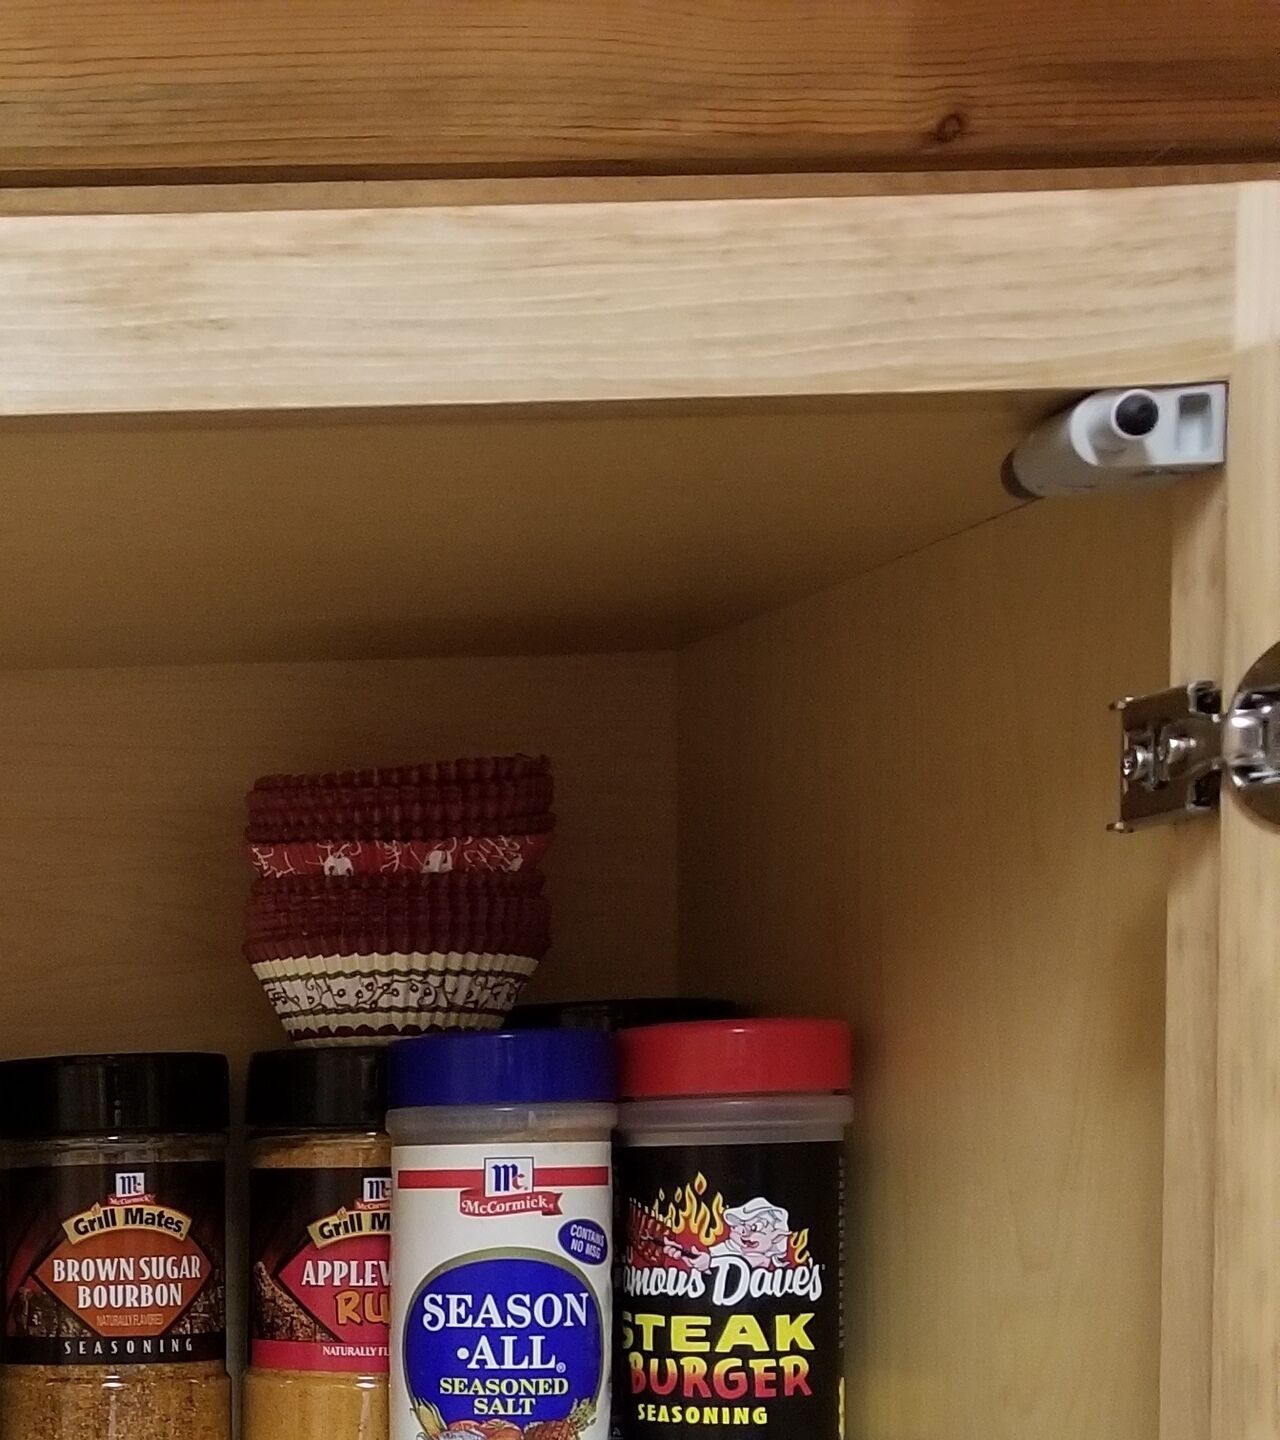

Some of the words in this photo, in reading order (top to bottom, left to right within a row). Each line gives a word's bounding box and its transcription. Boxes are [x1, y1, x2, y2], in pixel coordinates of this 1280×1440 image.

[461, 1193, 547, 1215] McCormick
[73, 1208, 117, 1236] Grill
[124, 1207, 184, 1234] Mates
[319, 1213, 363, 1240] Grill
[570, 1225, 604, 1248] CONTAINS
[570, 1238, 584, 1253] NO
[586, 1242, 601, 1258] MSG
[53, 1258, 135, 1283] BROWN
[139, 1255, 200, 1280] SUGAR
[624, 1264, 706, 1299] amous
[710, 1255, 822, 1306] Dave's
[78, 1283, 182, 1309] BOURBON
[337, 1292, 390, 1324] RU
[423, 1292, 589, 1331] SEASON
[65, 1338, 192, 1355] SEASONING
[323, 1346, 377, 1356] NATURALLY
[440, 1378, 568, 1396] SEASONED
[630, 1352, 812, 1399] BURGER
[474, 1398, 535, 1415] SALT
[638, 1404, 768, 1425] SEASONING
